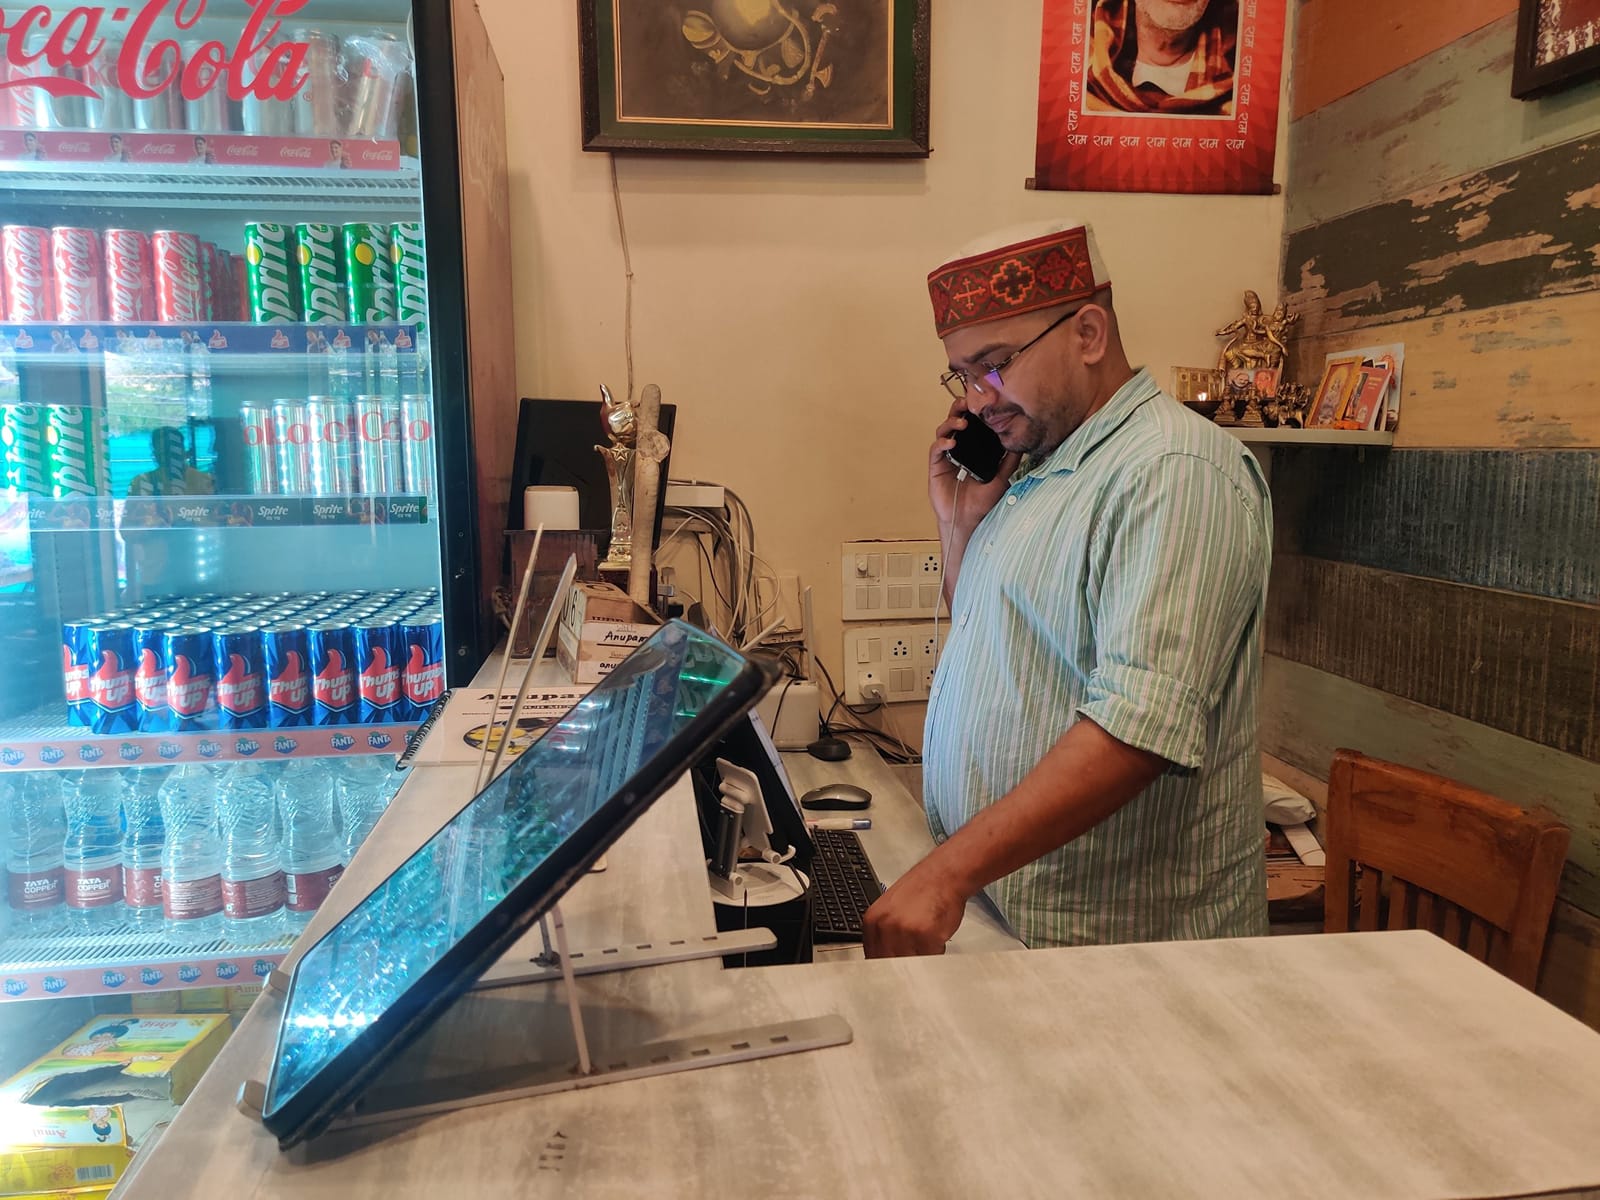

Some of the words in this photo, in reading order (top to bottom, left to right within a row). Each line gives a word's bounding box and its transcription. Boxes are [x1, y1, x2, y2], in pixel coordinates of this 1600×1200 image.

[1067, 134, 1088, 145] राम
[1093, 135, 1113, 146] राम
[1120, 135, 1140, 147] राम
[1146, 136, 1167, 148] राम
[1172, 137, 1192, 148] राम
[1199, 137, 1219, 149] राम
[1225, 138, 1245, 150] राम
[177, 506, 210, 519] Sprite
[258, 505, 289, 517] Sprite
[312, 504, 343, 516] Sprite
[390, 503, 419, 514] Sprite
[106, 685, 128, 701] UP
[331, 685, 351, 701] UP
[376, 682, 396, 698] UP
[413, 680, 434, 697] UP
[181, 691, 203, 708] UP
[234, 689, 256, 706] UP
[274, 740, 297, 751] FANTA
[331, 736, 354, 747] FANTA
[367, 734, 391, 745] FANTA
[119, 747, 143, 758] FANTA
[158, 744, 181, 755] FANTA
[197, 743, 221, 753] FANTA
[235, 741, 259, 752] FANTA
[0, 751, 25, 762] FANTA
[40, 749, 64, 761] FANTA
[79, 748, 103, 760] FANTA
[24, 879, 49, 887] TATA
[178, 967, 201, 978] FANTA
[216, 965, 239, 976] FANTA
[253, 961, 276, 973] FANTA
[102, 974, 125, 985] FANTA
[140, 970, 163, 981] FANTA
[4, 981, 28, 993] FANTA
[42, 978, 66, 990] FANTA
